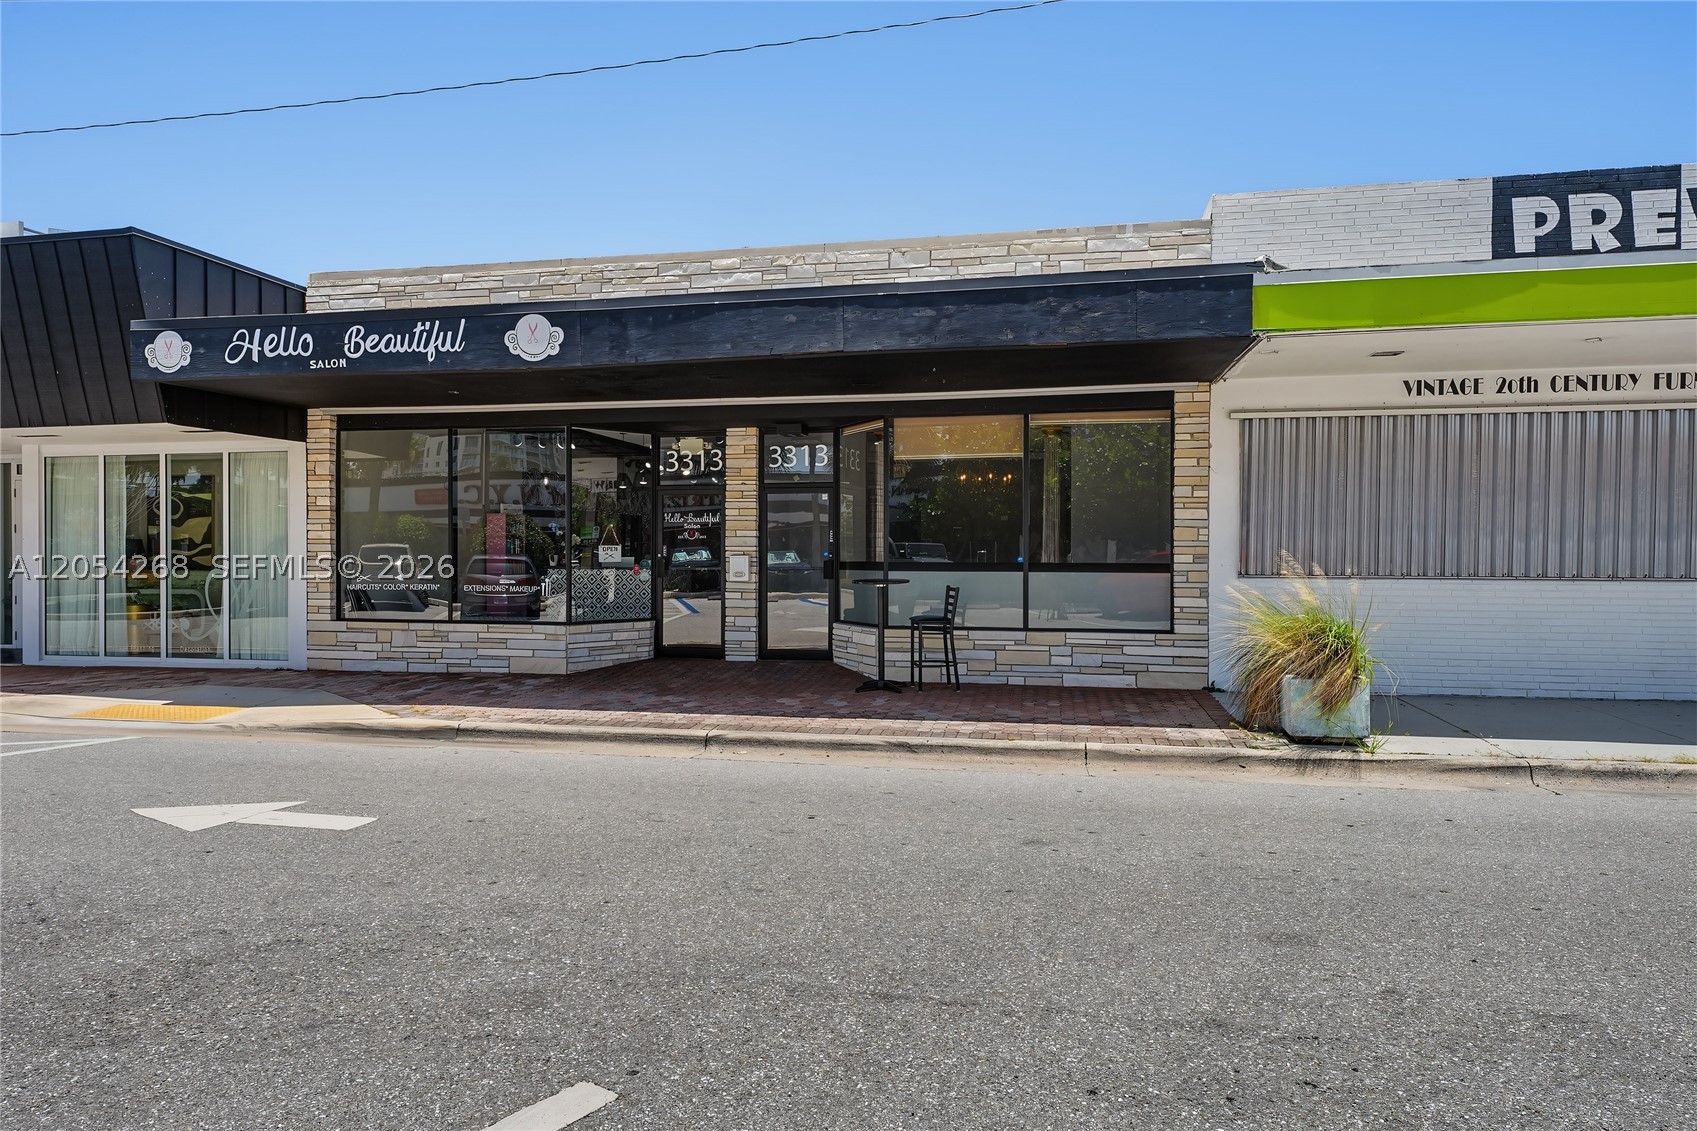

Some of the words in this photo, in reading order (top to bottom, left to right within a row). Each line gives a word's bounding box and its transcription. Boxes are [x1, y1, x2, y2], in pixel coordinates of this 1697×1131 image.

[1511, 188, 1697, 253] PRE
[224, 326, 314, 364] Hello
[343, 318, 466, 362] Beautiful
[309, 358, 347, 370] SALON
[1402, 377, 1484, 397] VINTAGE
[1549, 373, 1642, 393] CENTURY
[1653, 371, 1697, 391] FUR
[666, 449, 724, 473] 3313
[768, 444, 829, 468] 3313
[663, 512, 684, 523] Hello
